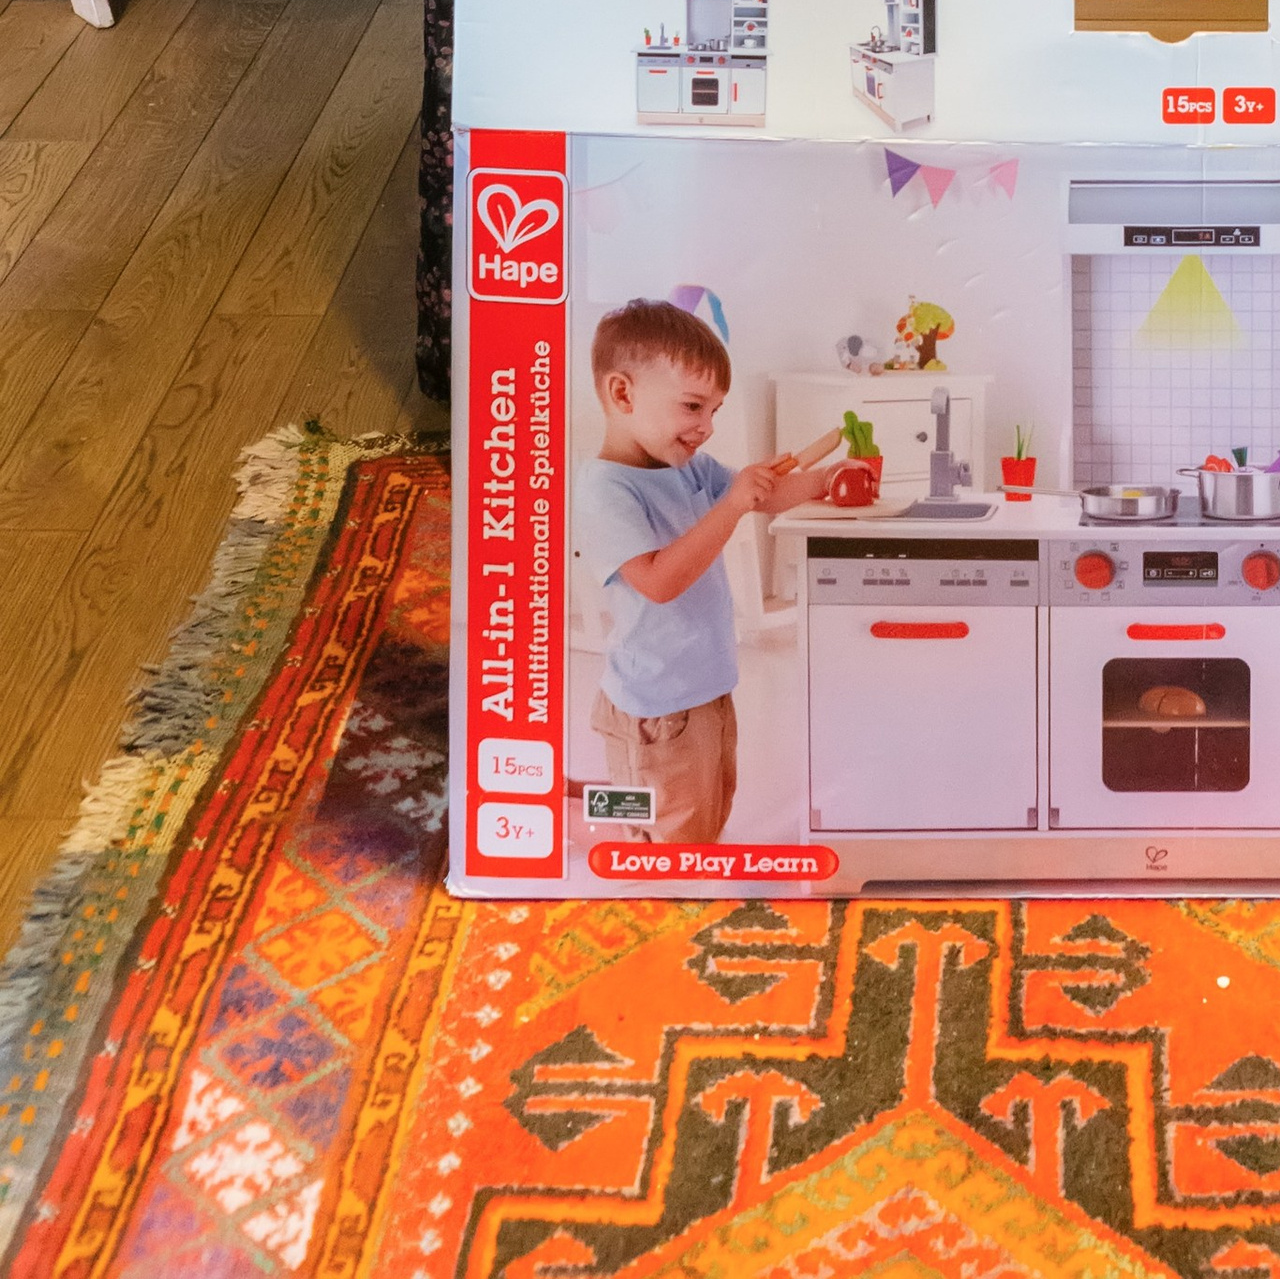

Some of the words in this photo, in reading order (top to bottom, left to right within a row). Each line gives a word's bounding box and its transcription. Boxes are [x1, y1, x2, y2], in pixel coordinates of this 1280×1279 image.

[479, 253, 558, 288] Hape
[483, 367, 516, 541] Kitchen
[530, 340, 555, 490] Spielküche
[482, 562, 515, 722] All-in-1
[528, 498, 550, 723] Multifunktionale
[610, 850, 671, 873] Love
[679, 851, 736, 877] Play
[743, 853, 819, 874] Learn
